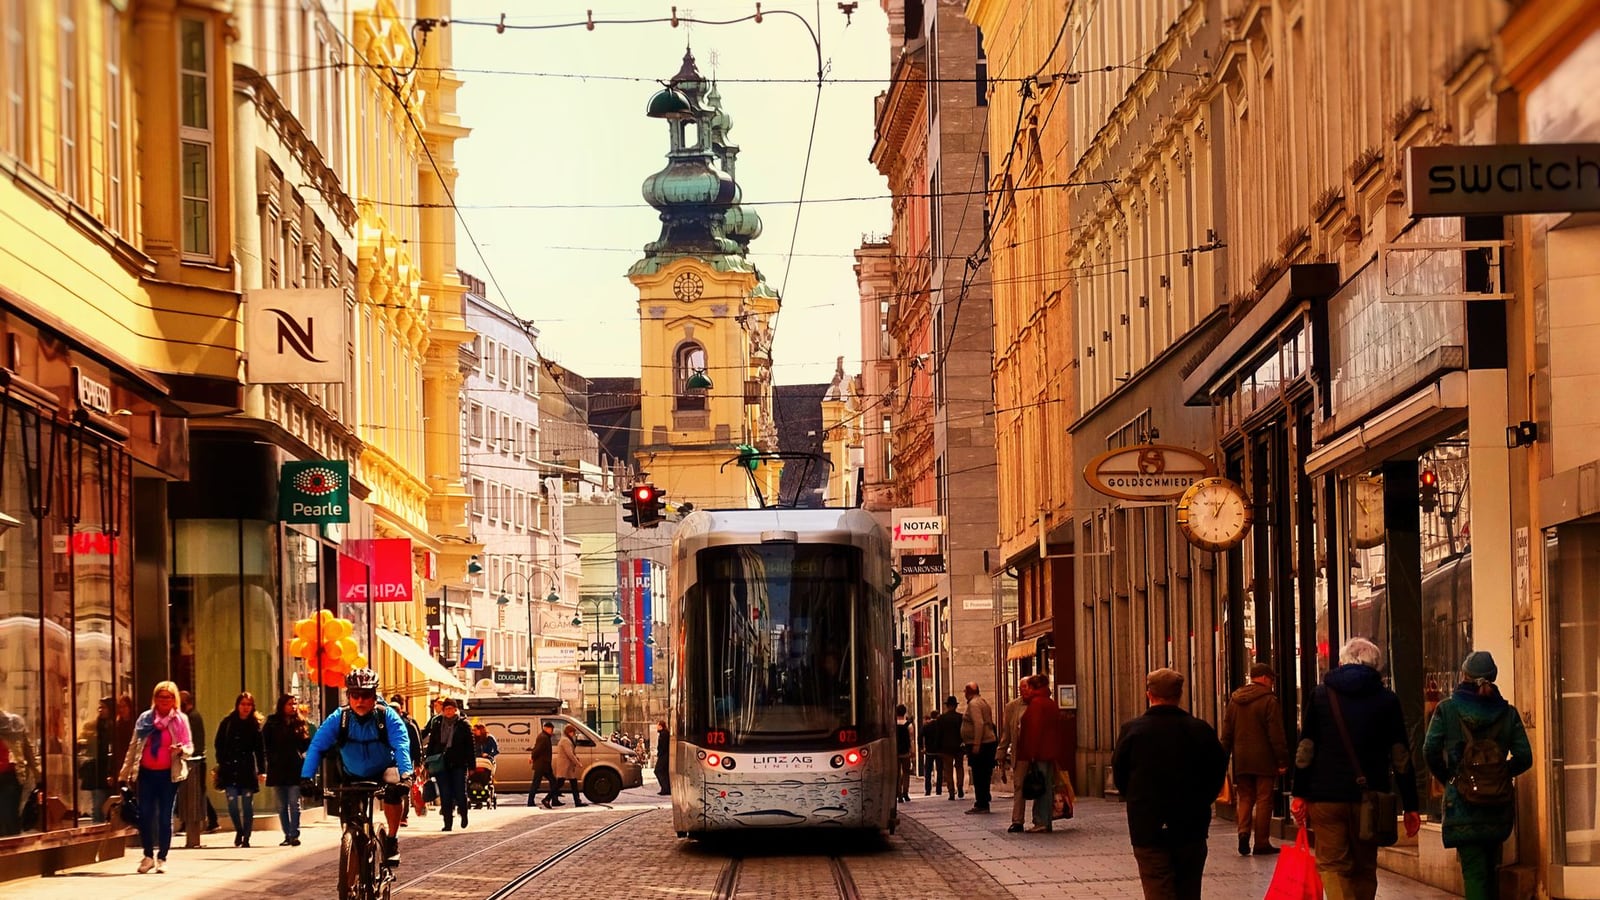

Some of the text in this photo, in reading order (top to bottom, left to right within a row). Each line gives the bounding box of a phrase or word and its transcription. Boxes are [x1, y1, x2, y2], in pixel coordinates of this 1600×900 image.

[1428, 155, 1600, 195] swatch
[263, 308, 328, 363] N
[1108, 478, 1194, 487] GOLDSCHMIEDE
[293, 503, 342, 517] Pearle
[904, 521, 939, 530] NOTAR
[903, 565, 942, 573] SWAROVSKI
[707, 732, 725, 744] 073
[839, 730, 857, 743] 073
[791, 756, 813, 764] AG
